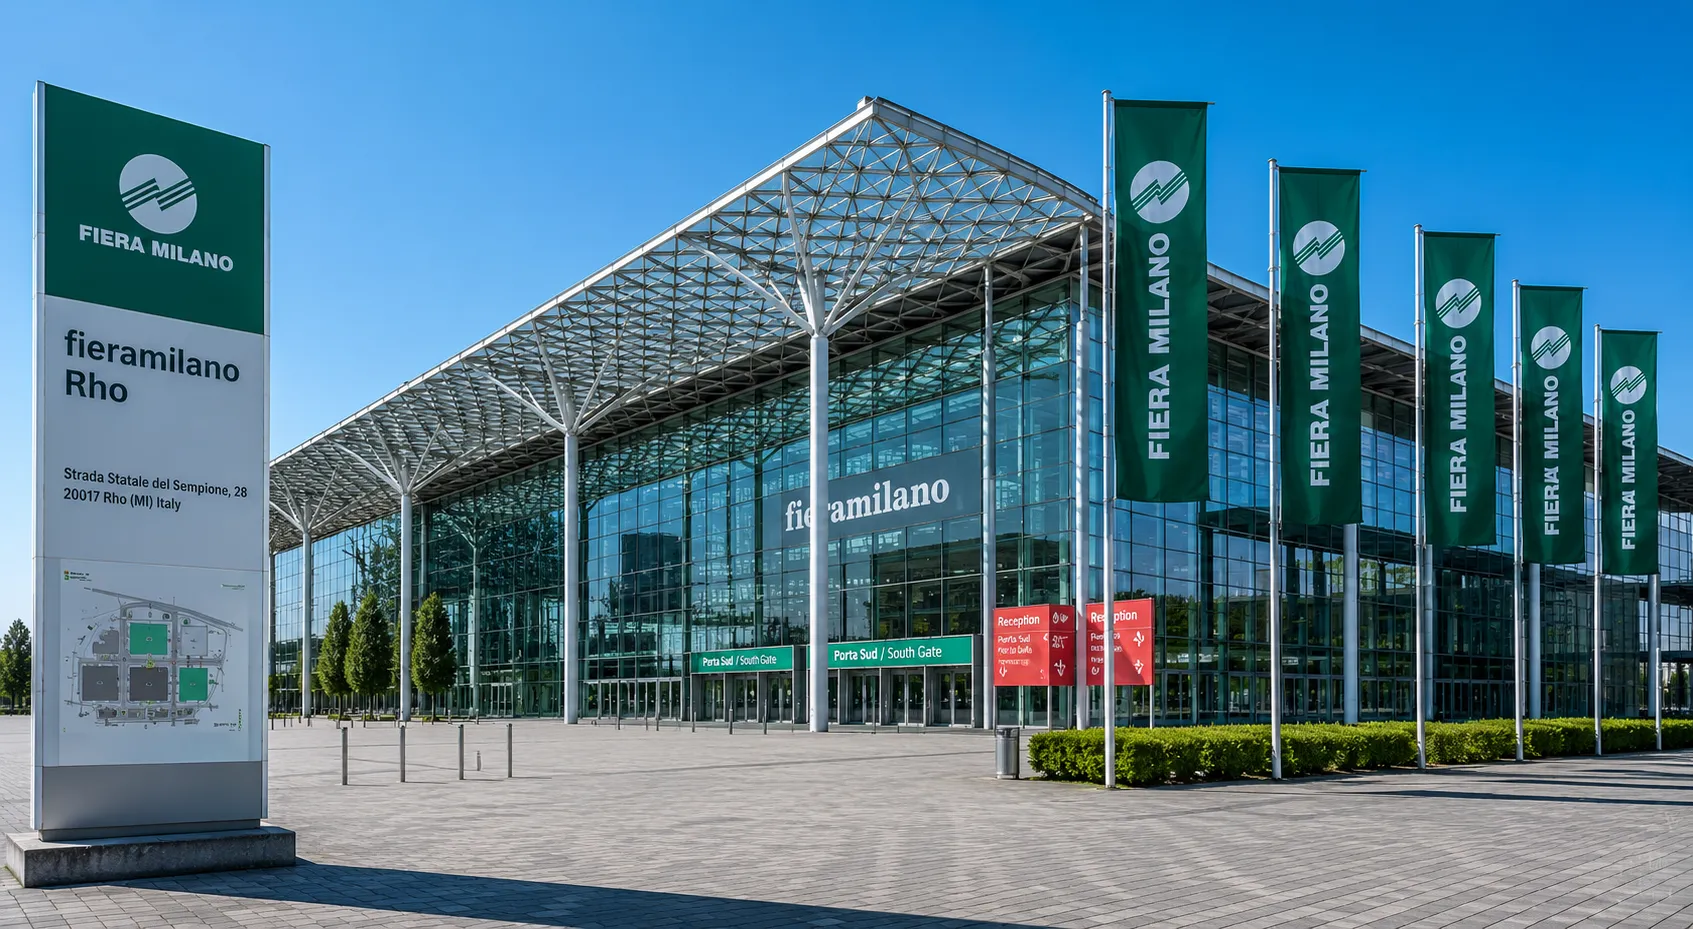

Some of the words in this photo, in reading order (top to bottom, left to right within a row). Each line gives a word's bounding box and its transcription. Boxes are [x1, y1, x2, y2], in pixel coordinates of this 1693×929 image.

[79, 223, 146, 254] FIERA
[151, 240, 234, 272] MILANO
[1148, 232, 1170, 354] MILANO
[64, 328, 241, 382] fieramilano
[1309, 283, 1329, 390] MILANO
[65, 368, 128, 403] Rho
[1148, 363, 1170, 460] FIERA
[1449, 335, 1467, 430] MILANO
[1310, 398, 1330, 486] FIERA
[1543, 375, 1559, 459] MILANO
[1621, 409, 1636, 484] MILANO
[63, 487, 100, 503] 20017
[103, 491, 127, 505] Rho
[130, 493, 153, 510] (MI)
[156, 497, 182, 513] Italy
[64, 467, 105, 484] Strada
[107, 472, 149, 488] Statale
[152, 477, 170, 490] del
[173, 479, 232, 499] Sempione,
[234, 485, 248, 498] 28
[1450, 437, 1467, 513] FIERA
[1544, 466, 1560, 536] FIERA
[1621, 489, 1636, 550] FIERA
[860, 647, 878, 660] Sud
[887, 646, 915, 659] South
[917, 645, 942, 659] Gate
[997, 614, 1040, 629] Reception
[740, 655, 760, 665] South
[760, 654, 777, 665] Gate
